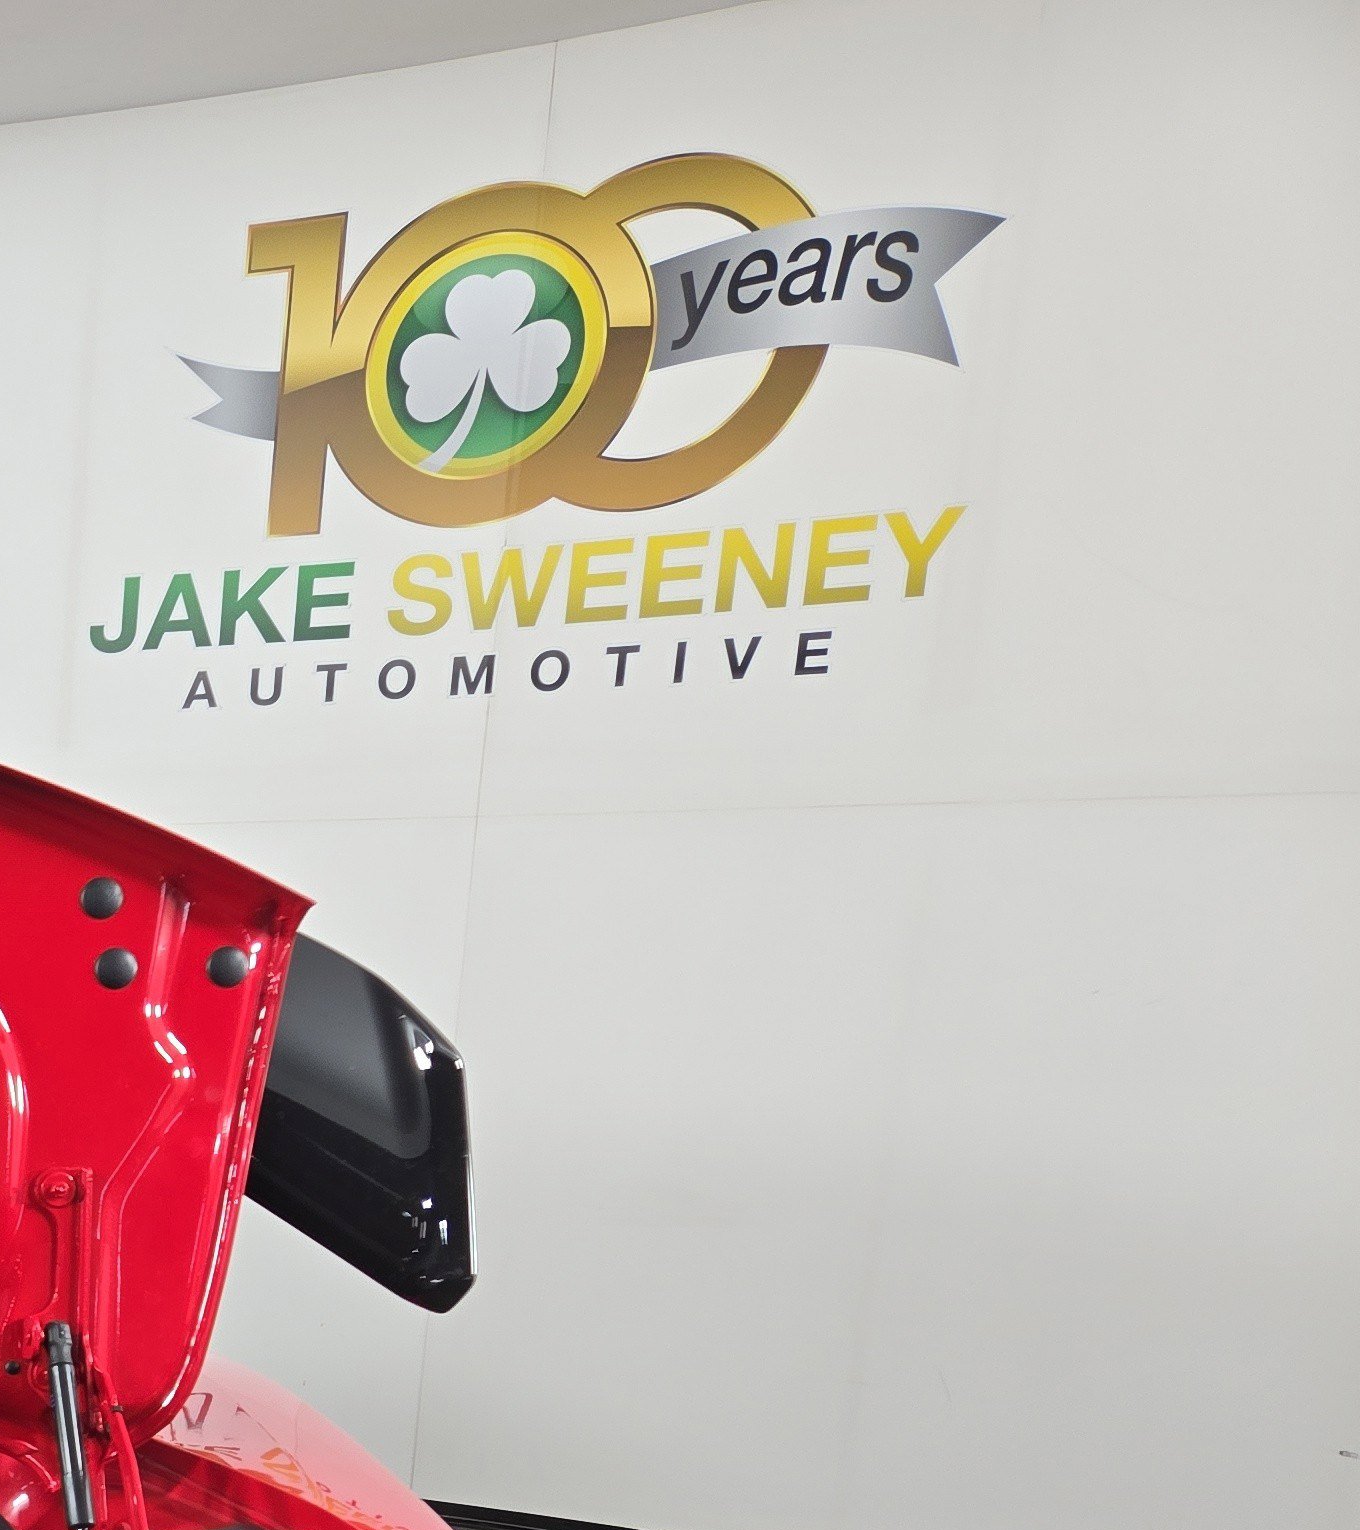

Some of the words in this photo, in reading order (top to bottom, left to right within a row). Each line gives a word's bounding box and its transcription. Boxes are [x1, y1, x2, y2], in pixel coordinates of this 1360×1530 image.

[246, 152, 829, 537] 100
[672, 229, 920, 350] years
[89, 561, 356, 654] JAKE
[387, 505, 968, 637] SWEENEY
[181, 630, 834, 711] AUTOMOTIVE
